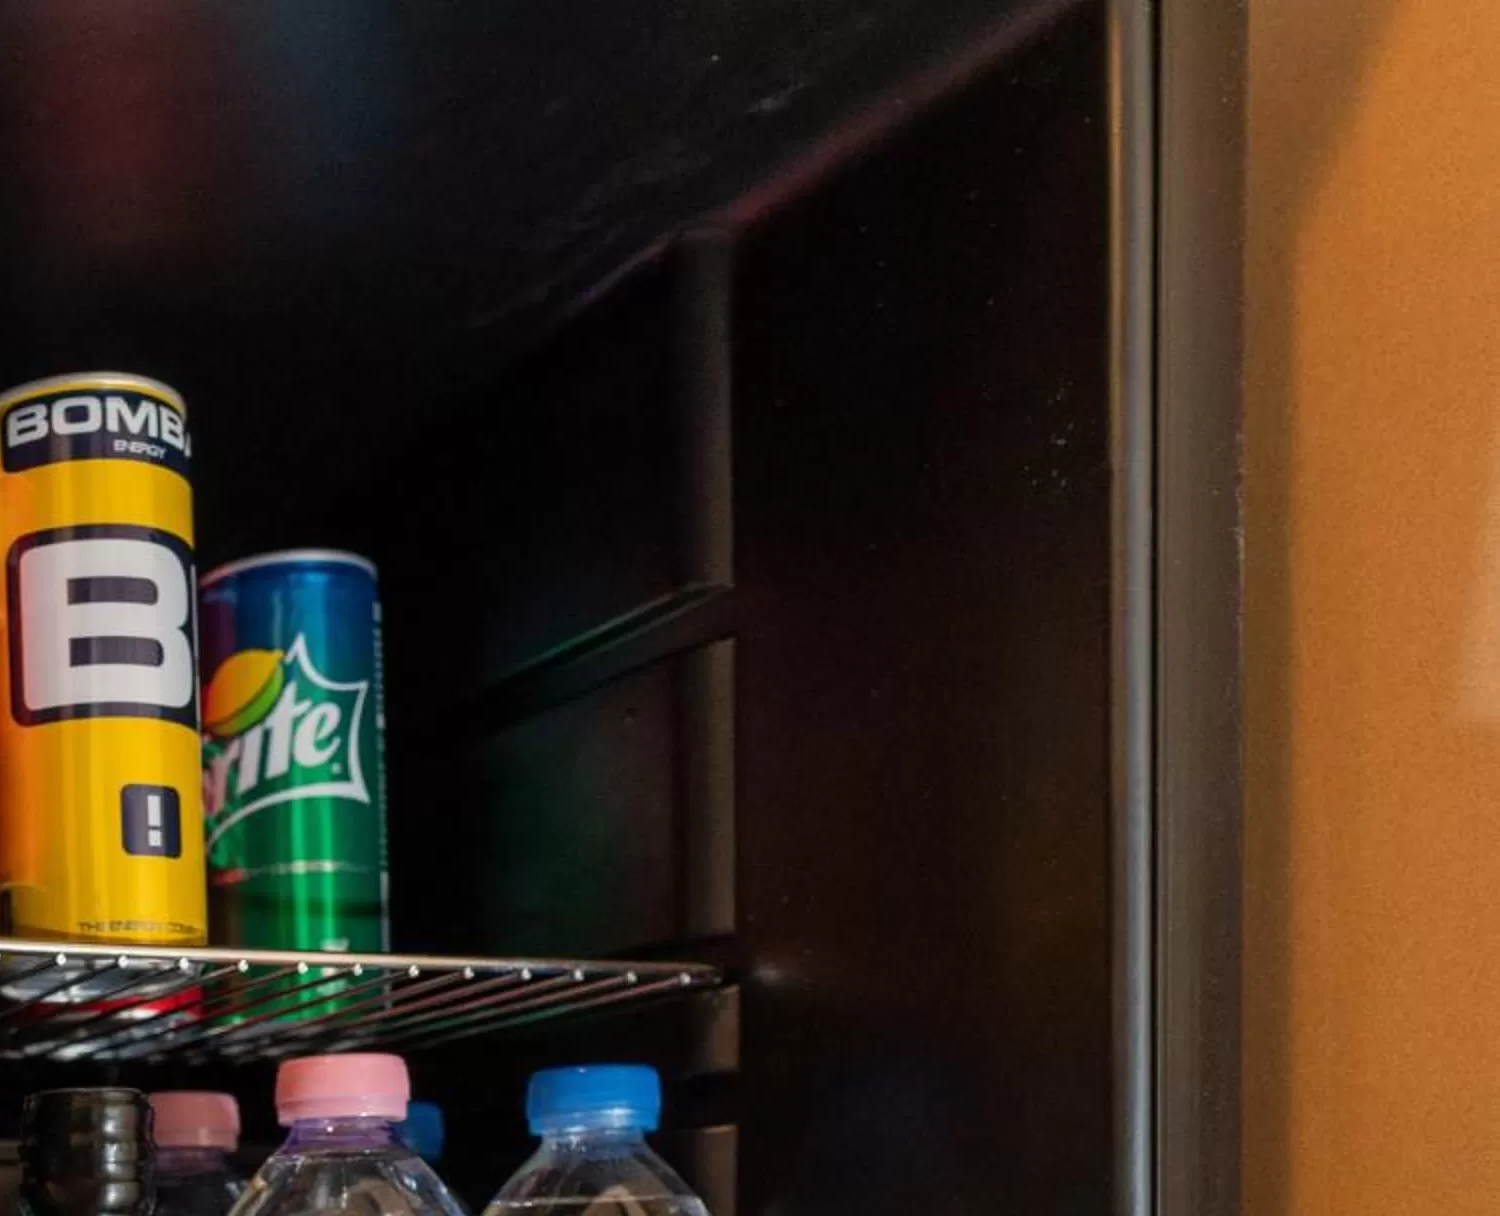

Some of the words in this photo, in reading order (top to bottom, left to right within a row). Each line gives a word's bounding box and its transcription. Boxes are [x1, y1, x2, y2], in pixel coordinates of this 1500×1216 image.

[6, 395, 192, 458] BOMB
[113, 439, 167, 459] ENERGY
[18, 538, 195, 711] B
[203, 679, 342, 816] rite
